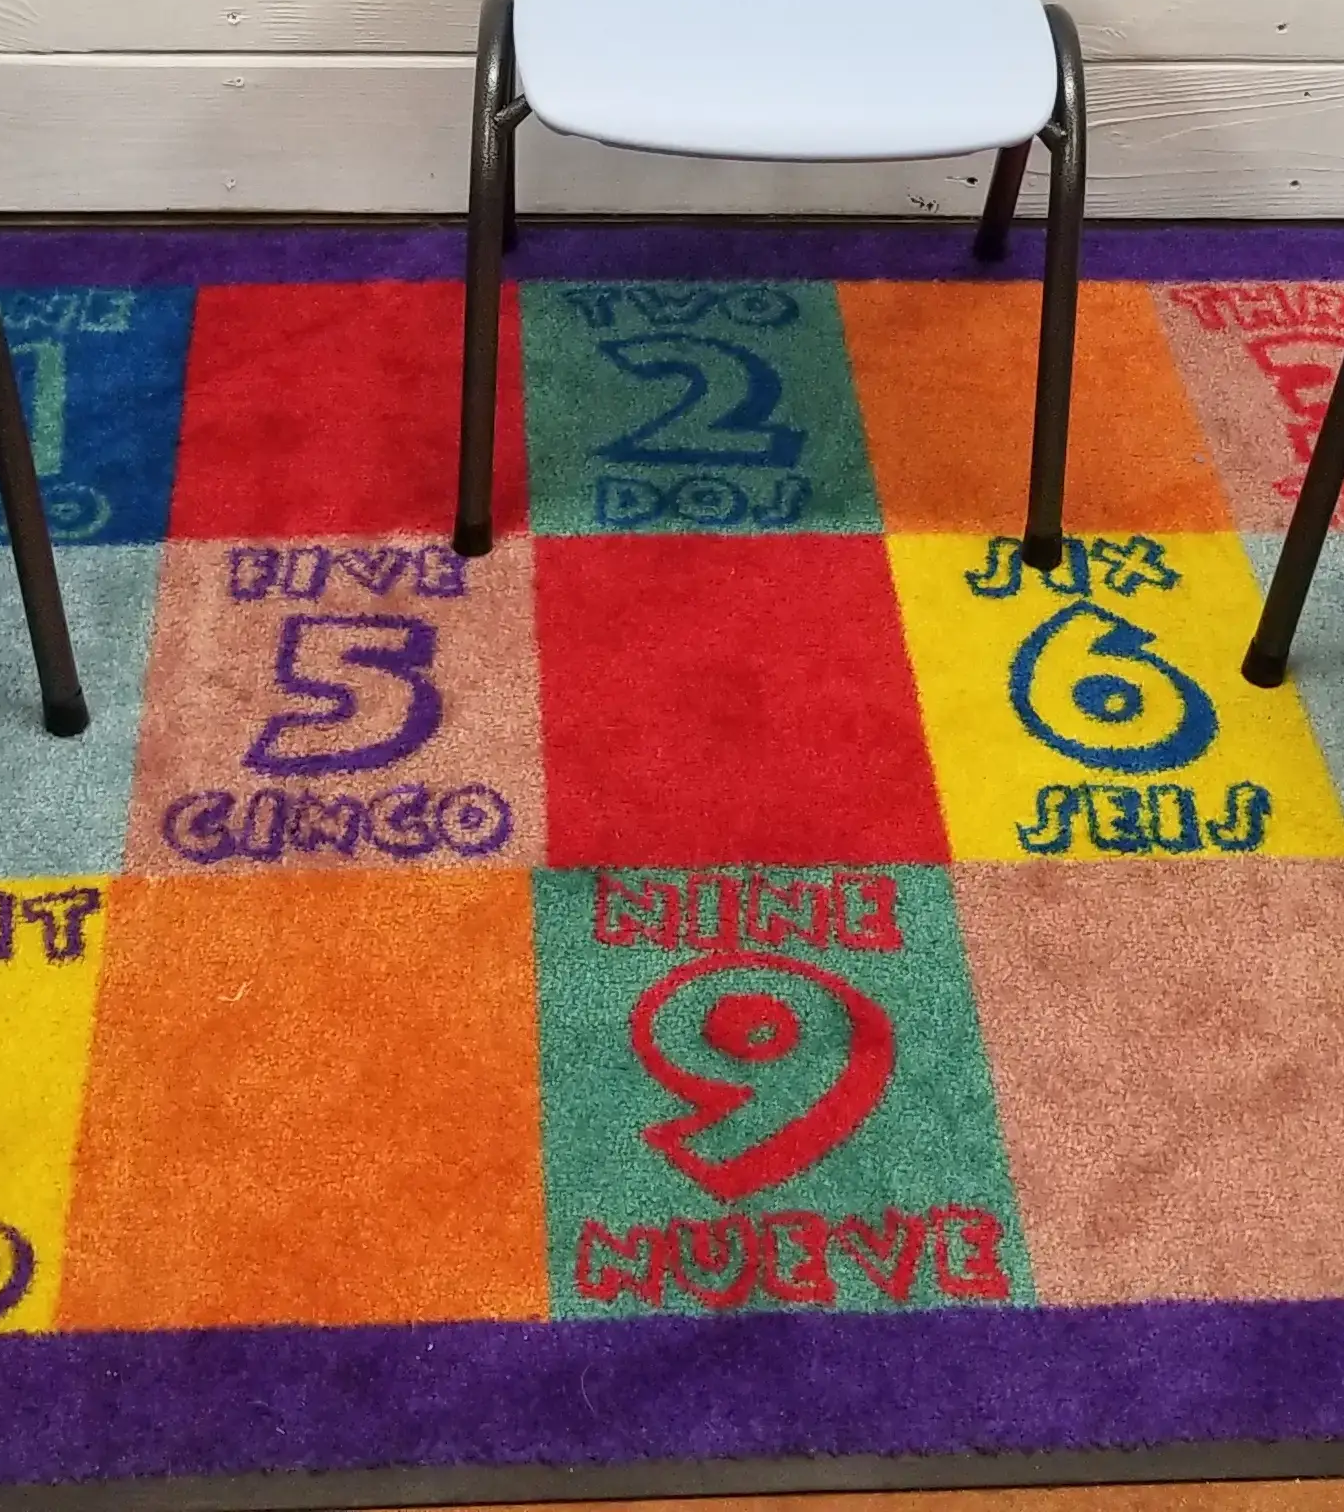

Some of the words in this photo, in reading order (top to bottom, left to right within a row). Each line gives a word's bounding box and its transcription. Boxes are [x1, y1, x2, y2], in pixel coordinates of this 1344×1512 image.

[566, 287, 801, 328] TWO
[590, 332, 810, 468] 2
[595, 474, 814, 527] DOS
[228, 545, 469, 601] FIVE
[964, 535, 1182, 599] SIX
[241, 613, 443, 777] 5
[1008, 599, 1220, 774] 6
[162, 781, 514, 864] CINCO
[1015, 780, 1273, 856] SEIS
[592, 873, 906, 953] NINE
[629, 950, 897, 1203] 9
[574, 1204, 1012, 1310] NUEVE
